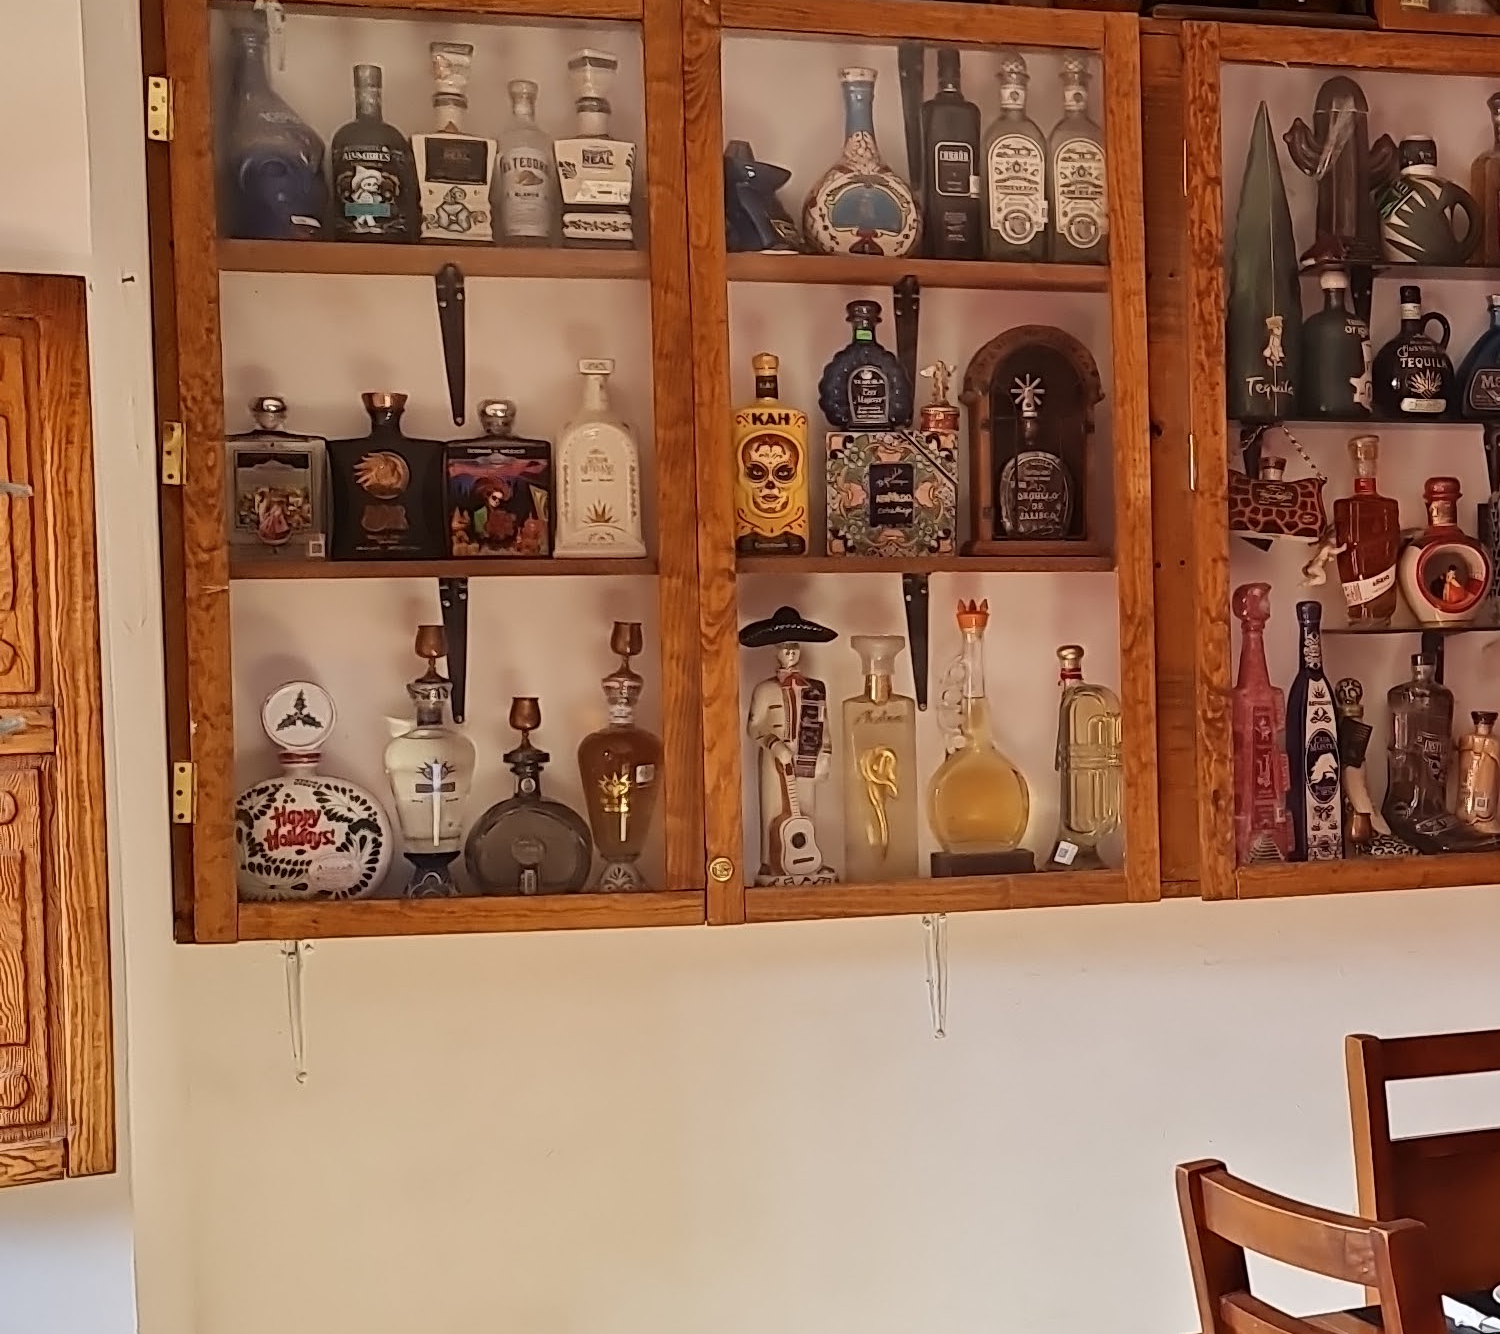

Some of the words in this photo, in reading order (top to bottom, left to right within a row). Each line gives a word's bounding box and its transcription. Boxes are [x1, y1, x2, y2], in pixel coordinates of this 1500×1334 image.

[1399, 357, 1447, 368] TEQUILA
[1246, 376, 1294, 400] Tequila
[752, 413, 790, 425] KAH
[1017, 492, 1059, 501] ORGULLO
[1019, 512, 1056, 521] JALISCO
[269, 805, 321, 828] Happy
